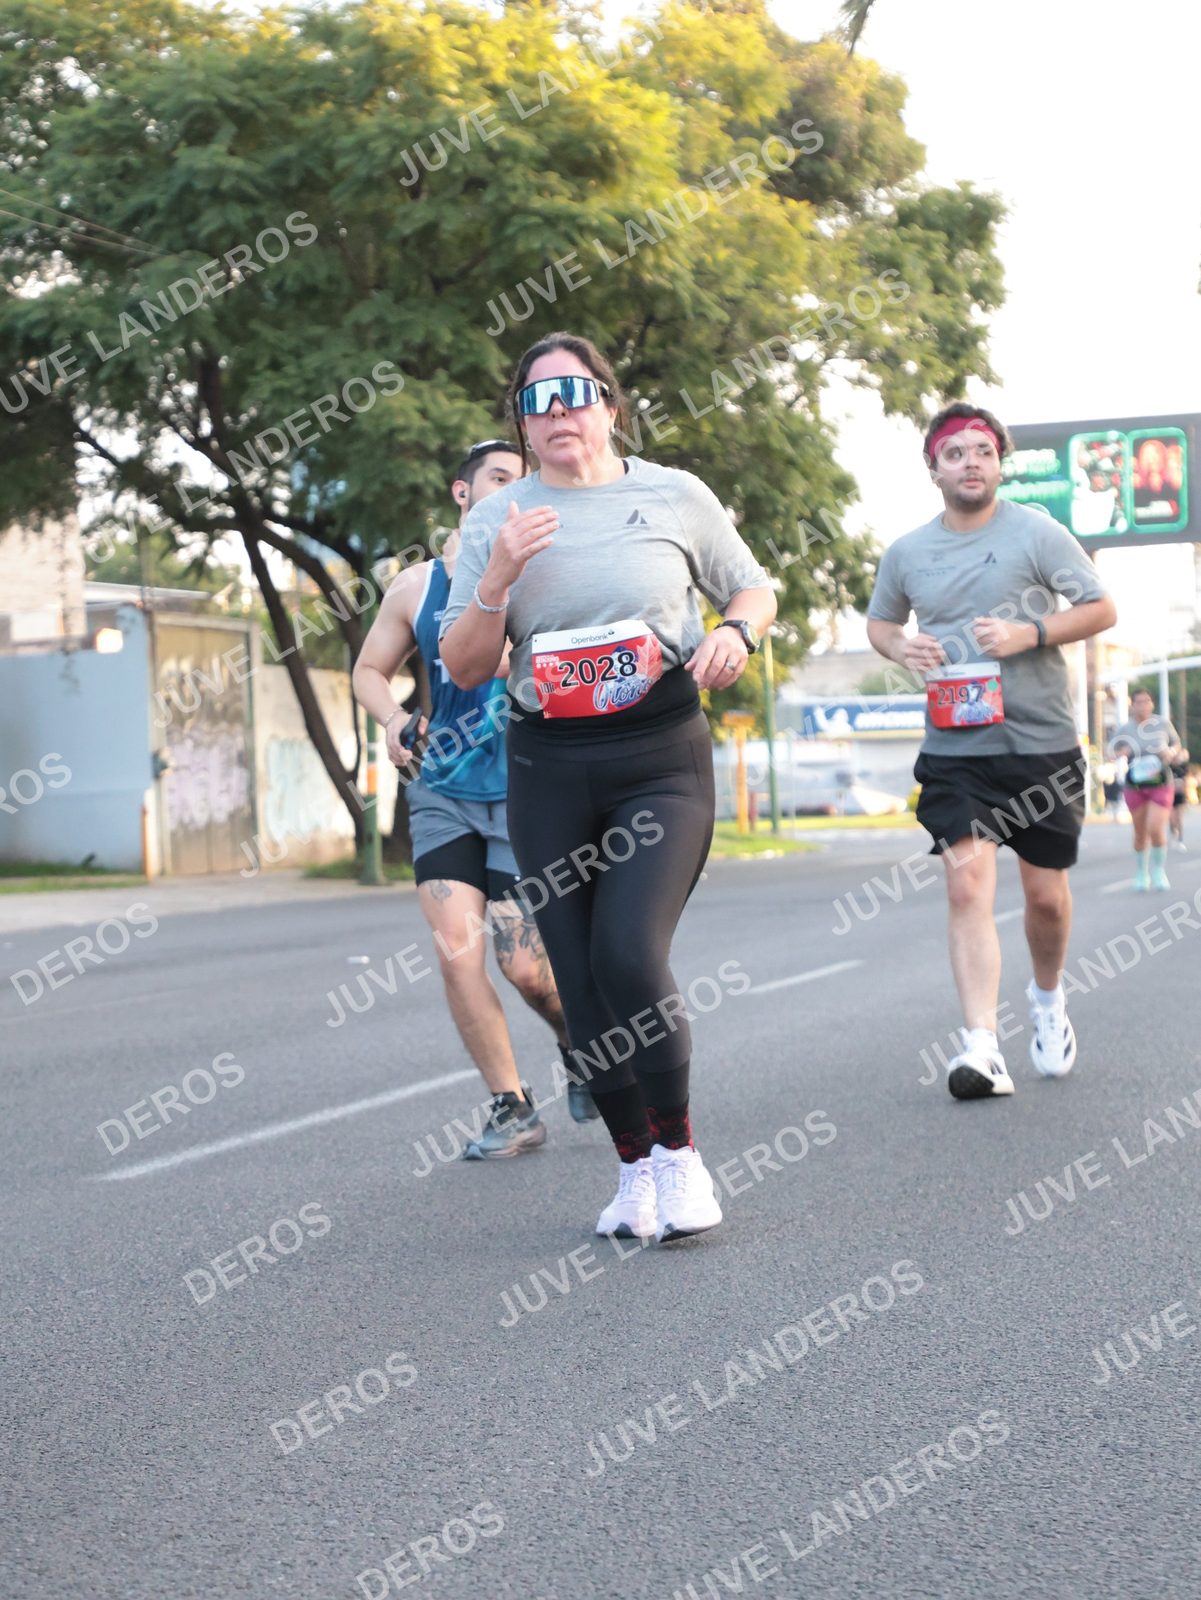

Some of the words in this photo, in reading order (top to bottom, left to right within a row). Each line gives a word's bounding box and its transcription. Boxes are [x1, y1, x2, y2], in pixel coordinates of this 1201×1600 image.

[571, 632, 609, 645] Openbank
[558, 650, 638, 689] 2028
[936, 684, 984, 707] 2197
